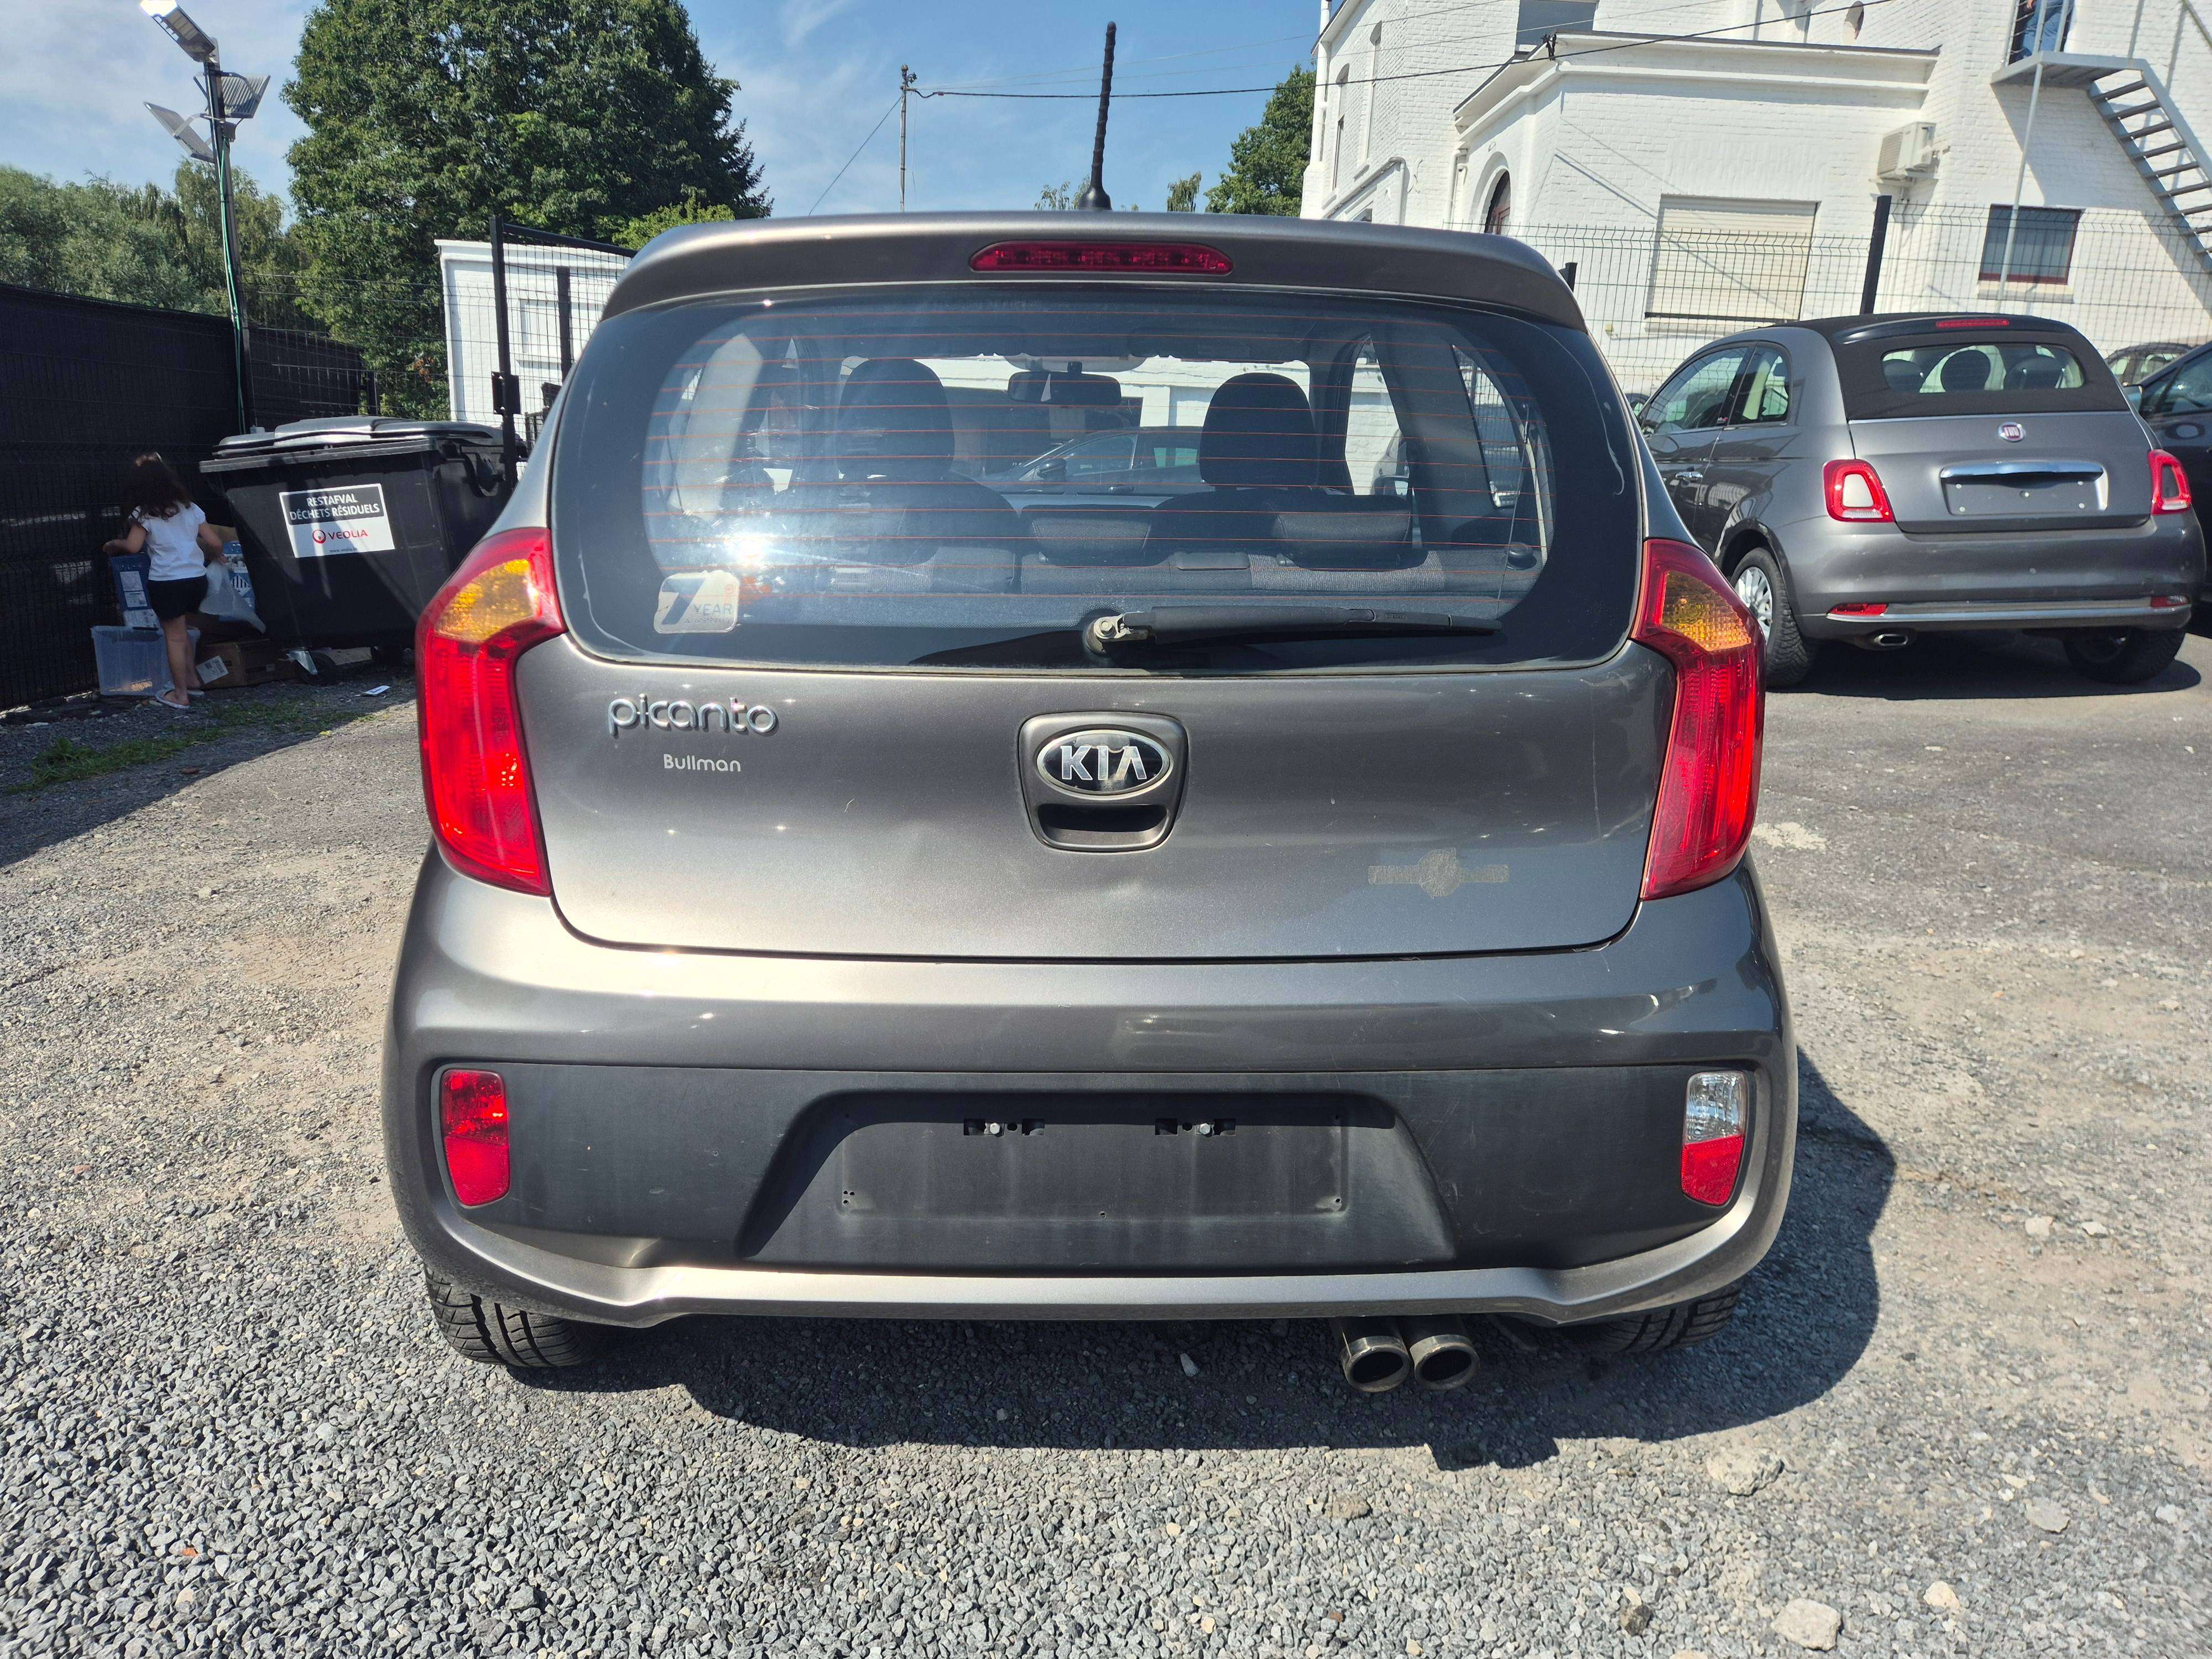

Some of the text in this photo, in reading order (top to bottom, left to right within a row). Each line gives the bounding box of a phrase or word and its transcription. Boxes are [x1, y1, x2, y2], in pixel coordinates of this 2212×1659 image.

[306, 493, 358, 507] RESTAFVAL
[289, 503, 380, 520] DÉCHETS RÉSIDUELS
[328, 529, 369, 540] VEOLIA
[693, 603, 733, 615] YEAR
[608, 693, 775, 735] picanto
[664, 754, 741, 773] Bullman
[1060, 745, 1147, 780] KIA
